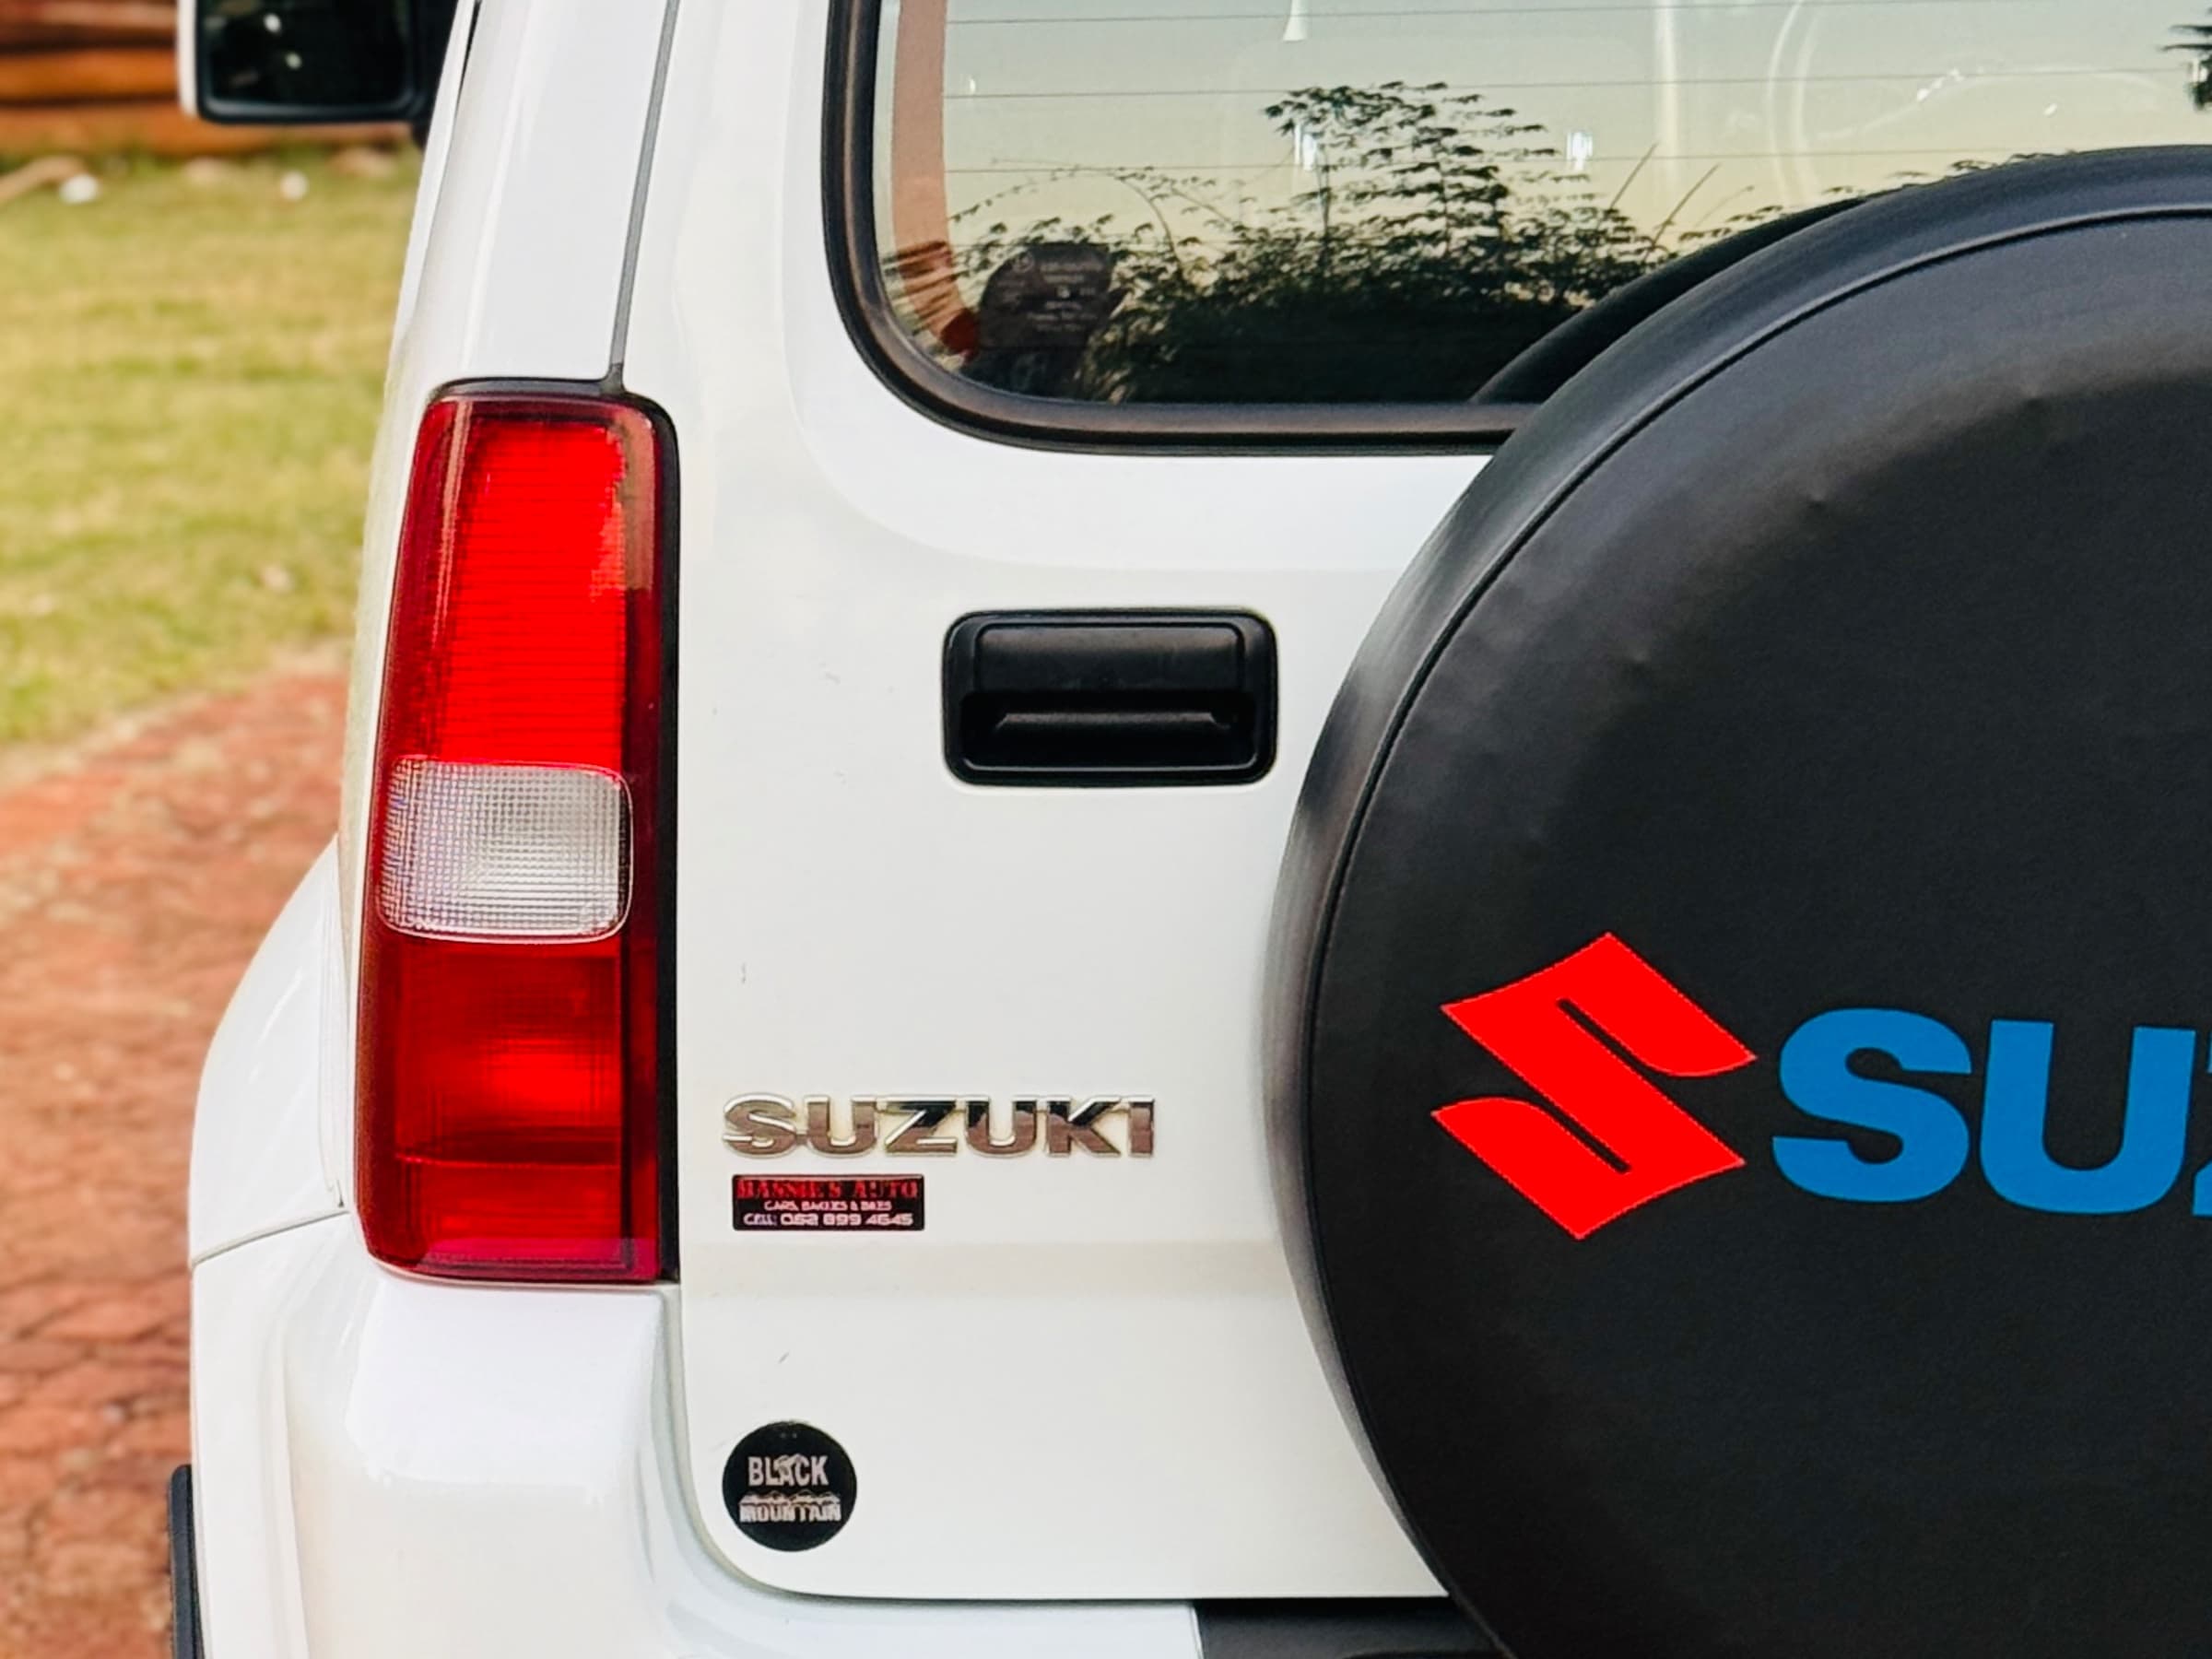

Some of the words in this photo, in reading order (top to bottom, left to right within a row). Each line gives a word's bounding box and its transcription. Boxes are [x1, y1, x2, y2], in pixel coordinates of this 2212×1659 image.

[723, 1093, 1157, 1159] SUZUKI
[1772, 1007, 2212, 1217] SU
[853, 1179, 918, 1198] AUTO
[747, 1453, 829, 1487] BLACK
[739, 1500, 841, 1523] MOUNTAIN
